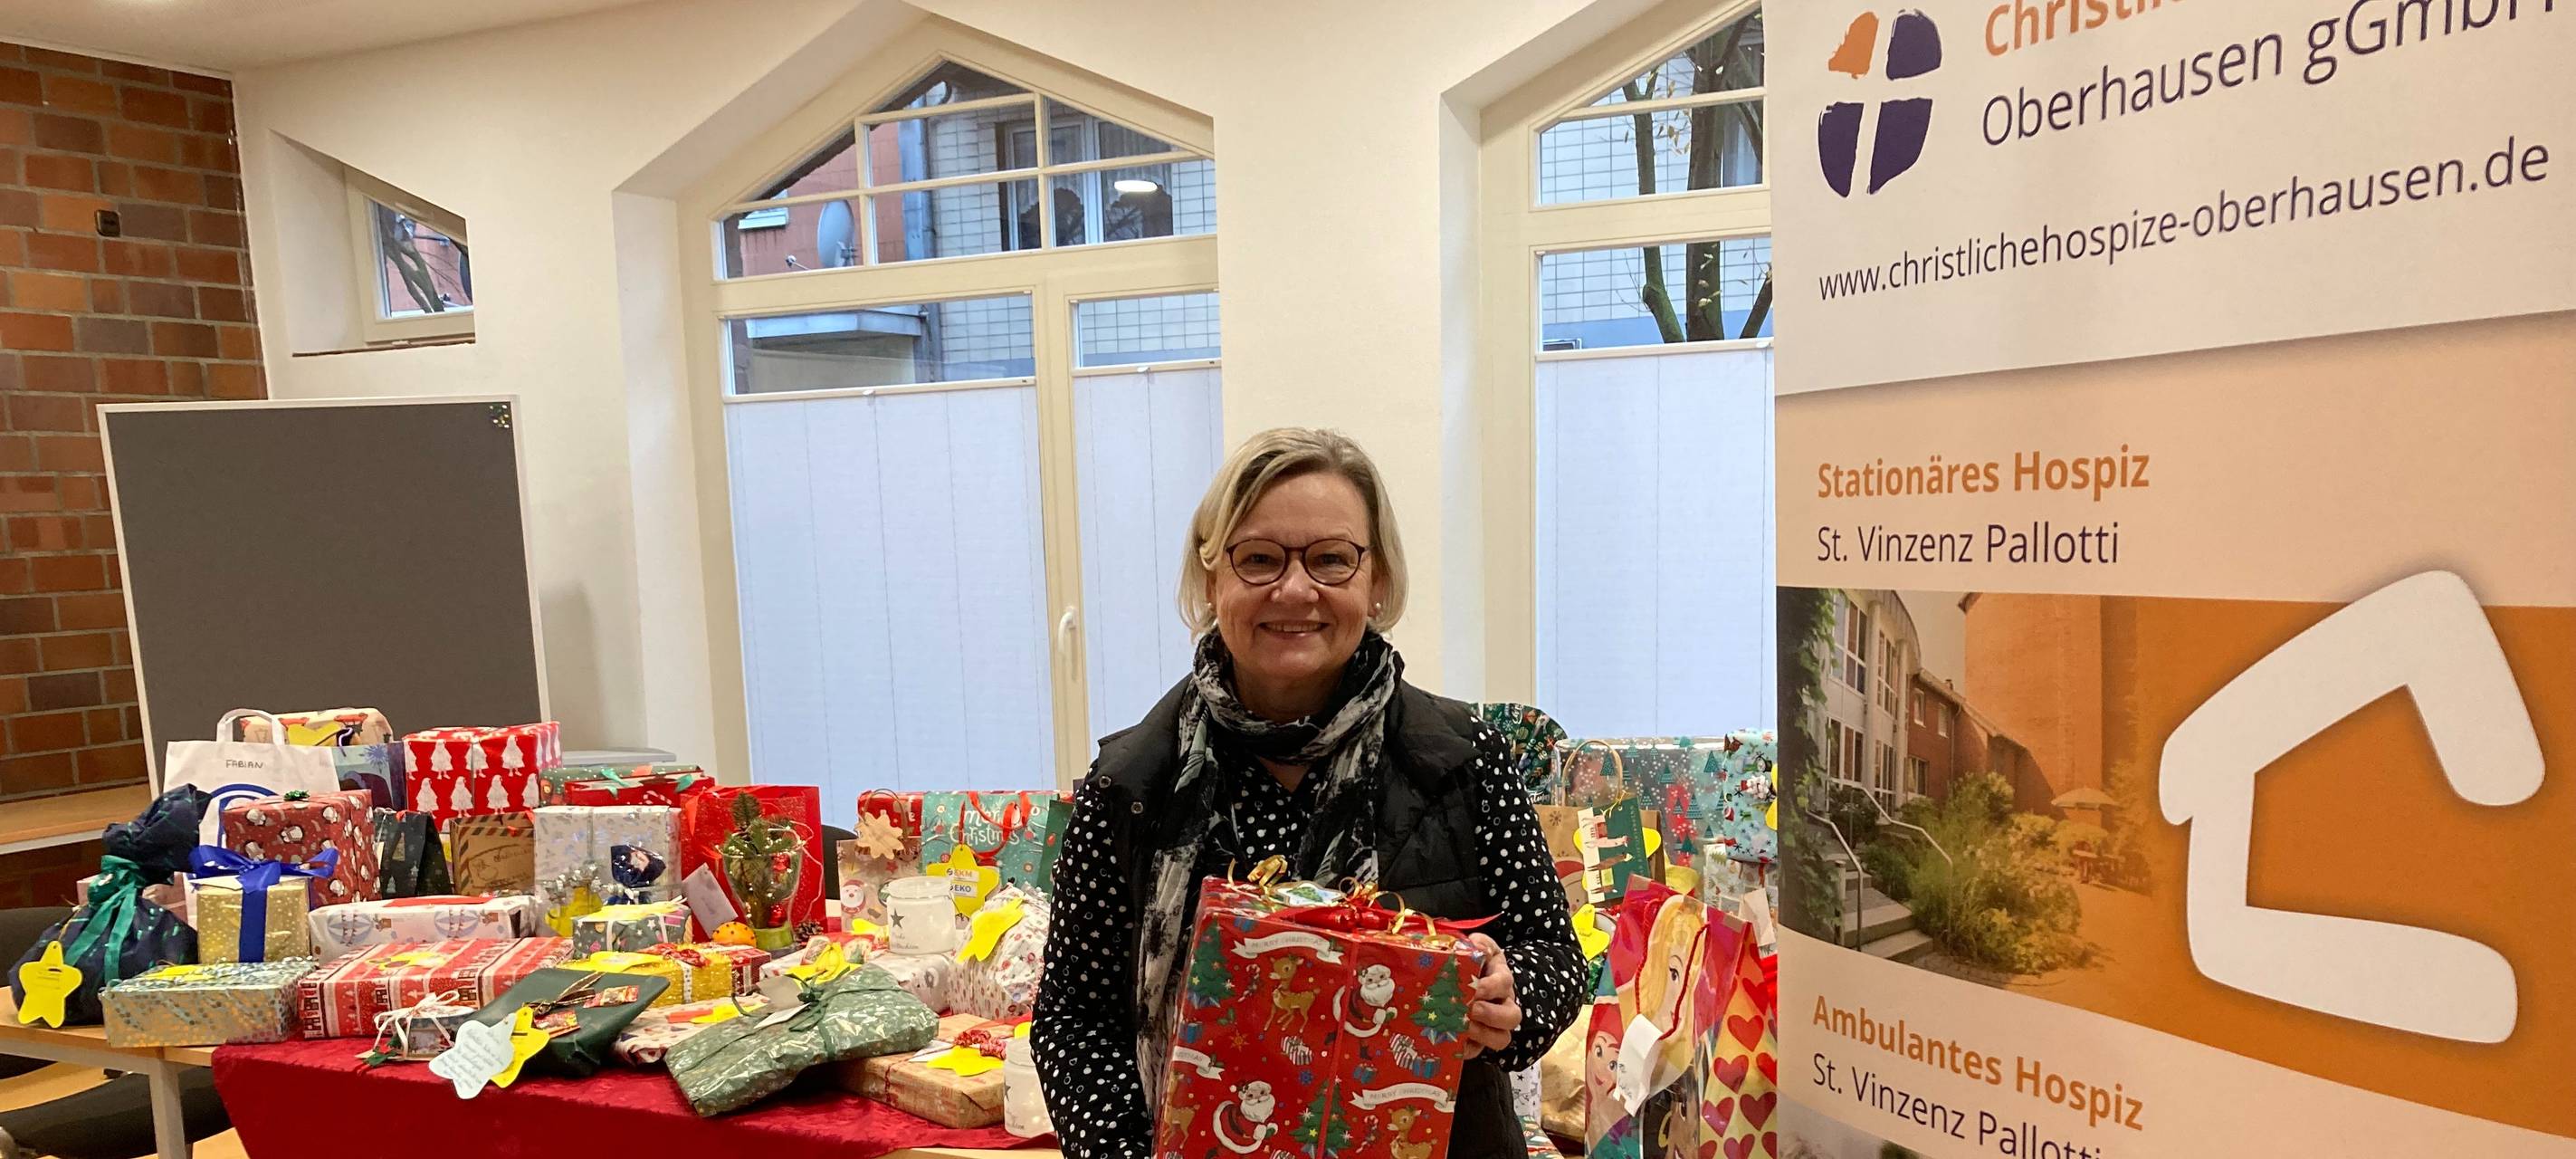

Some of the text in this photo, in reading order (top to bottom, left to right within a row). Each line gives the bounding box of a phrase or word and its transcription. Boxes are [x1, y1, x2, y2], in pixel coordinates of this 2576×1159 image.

[1985, 0, 2183, 56] Chris
[1982, 0, 2553, 146] Oberhausen gGm
[1818, 135, 2549, 301] www.christlichehospize-oberhausen.de
[1818, 444, 2150, 502] Stationäres Hospiz
[1818, 521, 2119, 564] St. Vinzenz Pallotti
[225, 759, 264, 769] FABIAN
[949, 823, 1021, 847] Cristms
[954, 884, 972, 893] EKO
[1813, 995, 2144, 1132] Ambulantes Hospiz
[1813, 1052, 2101, 1159] St. Vinzenz Pallot
